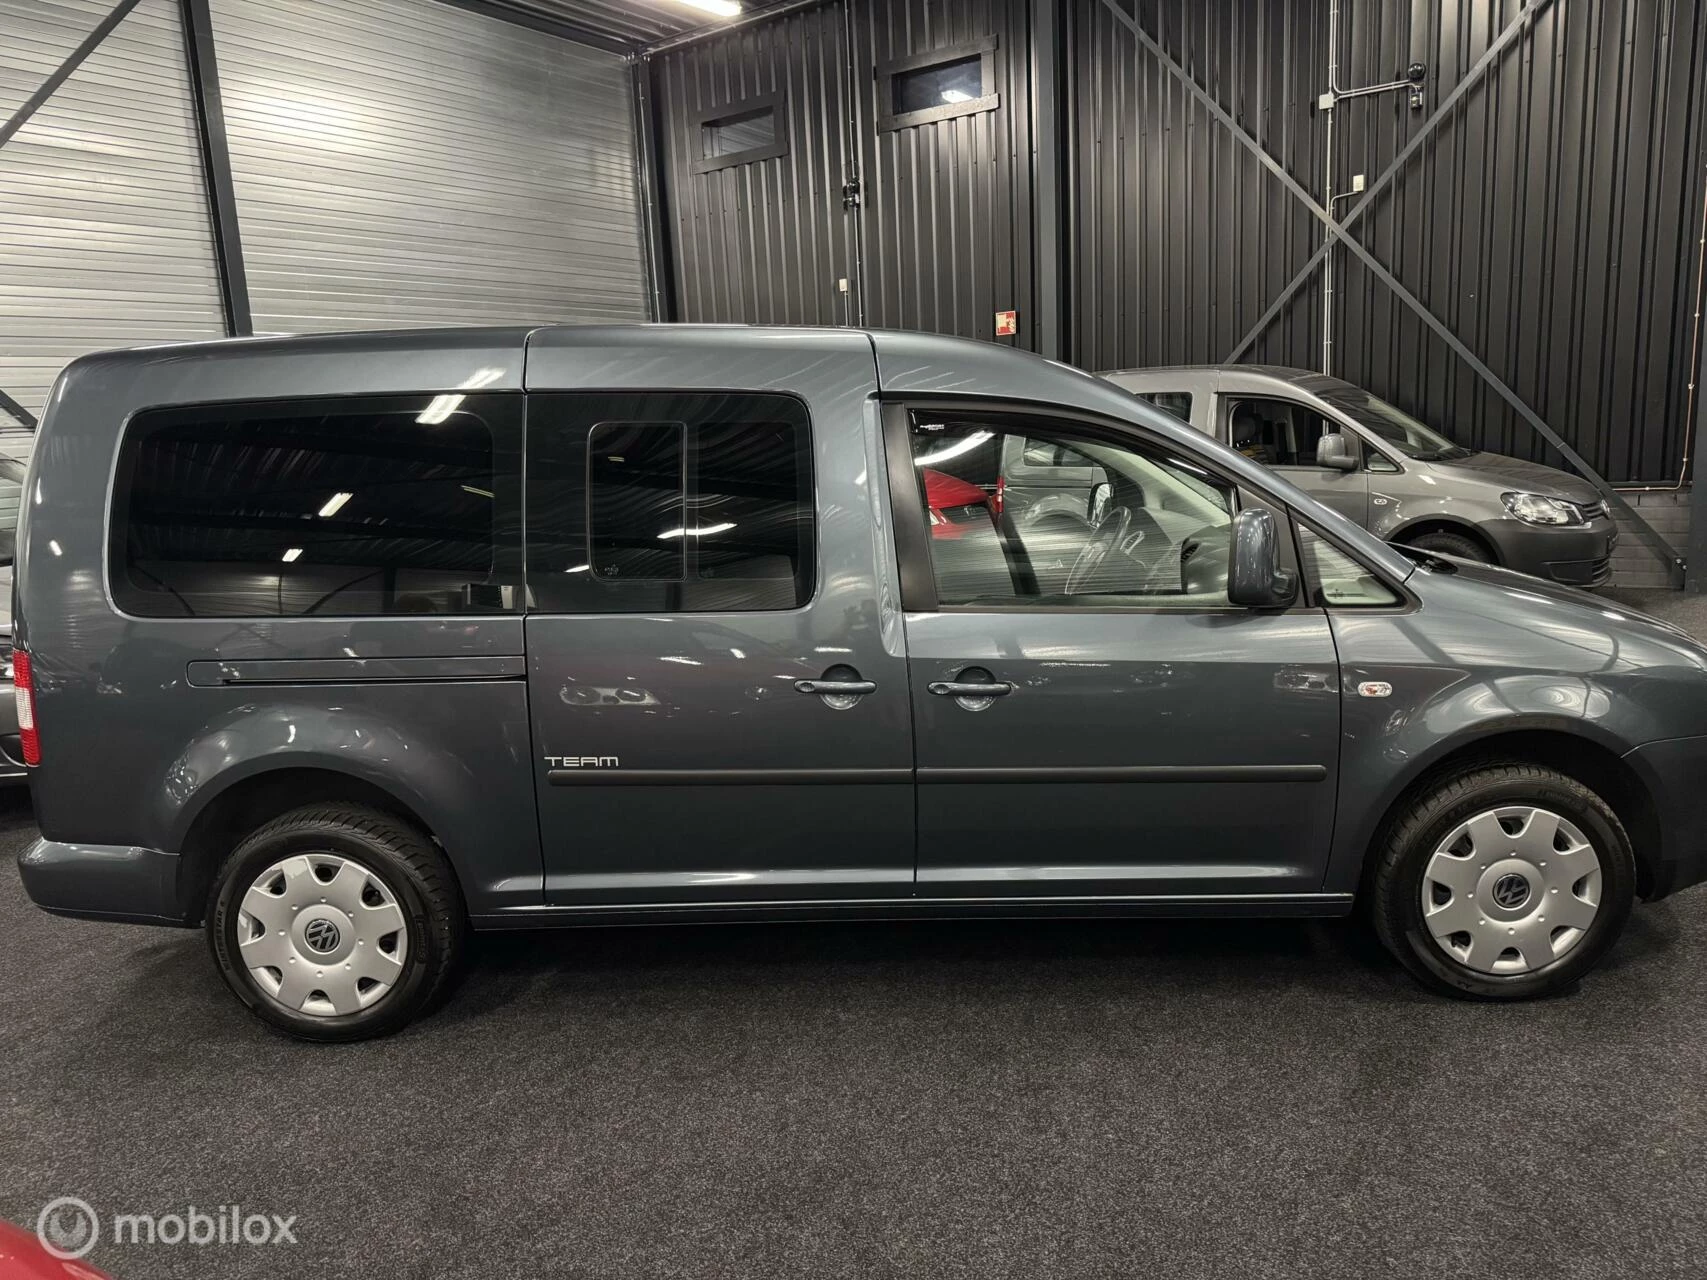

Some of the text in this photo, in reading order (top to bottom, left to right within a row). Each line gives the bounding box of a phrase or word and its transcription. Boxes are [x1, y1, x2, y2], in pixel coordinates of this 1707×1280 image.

[543, 756, 619, 767] TEAM
[1493, 873, 1530, 909] VW
[305, 918, 340, 953] VW
